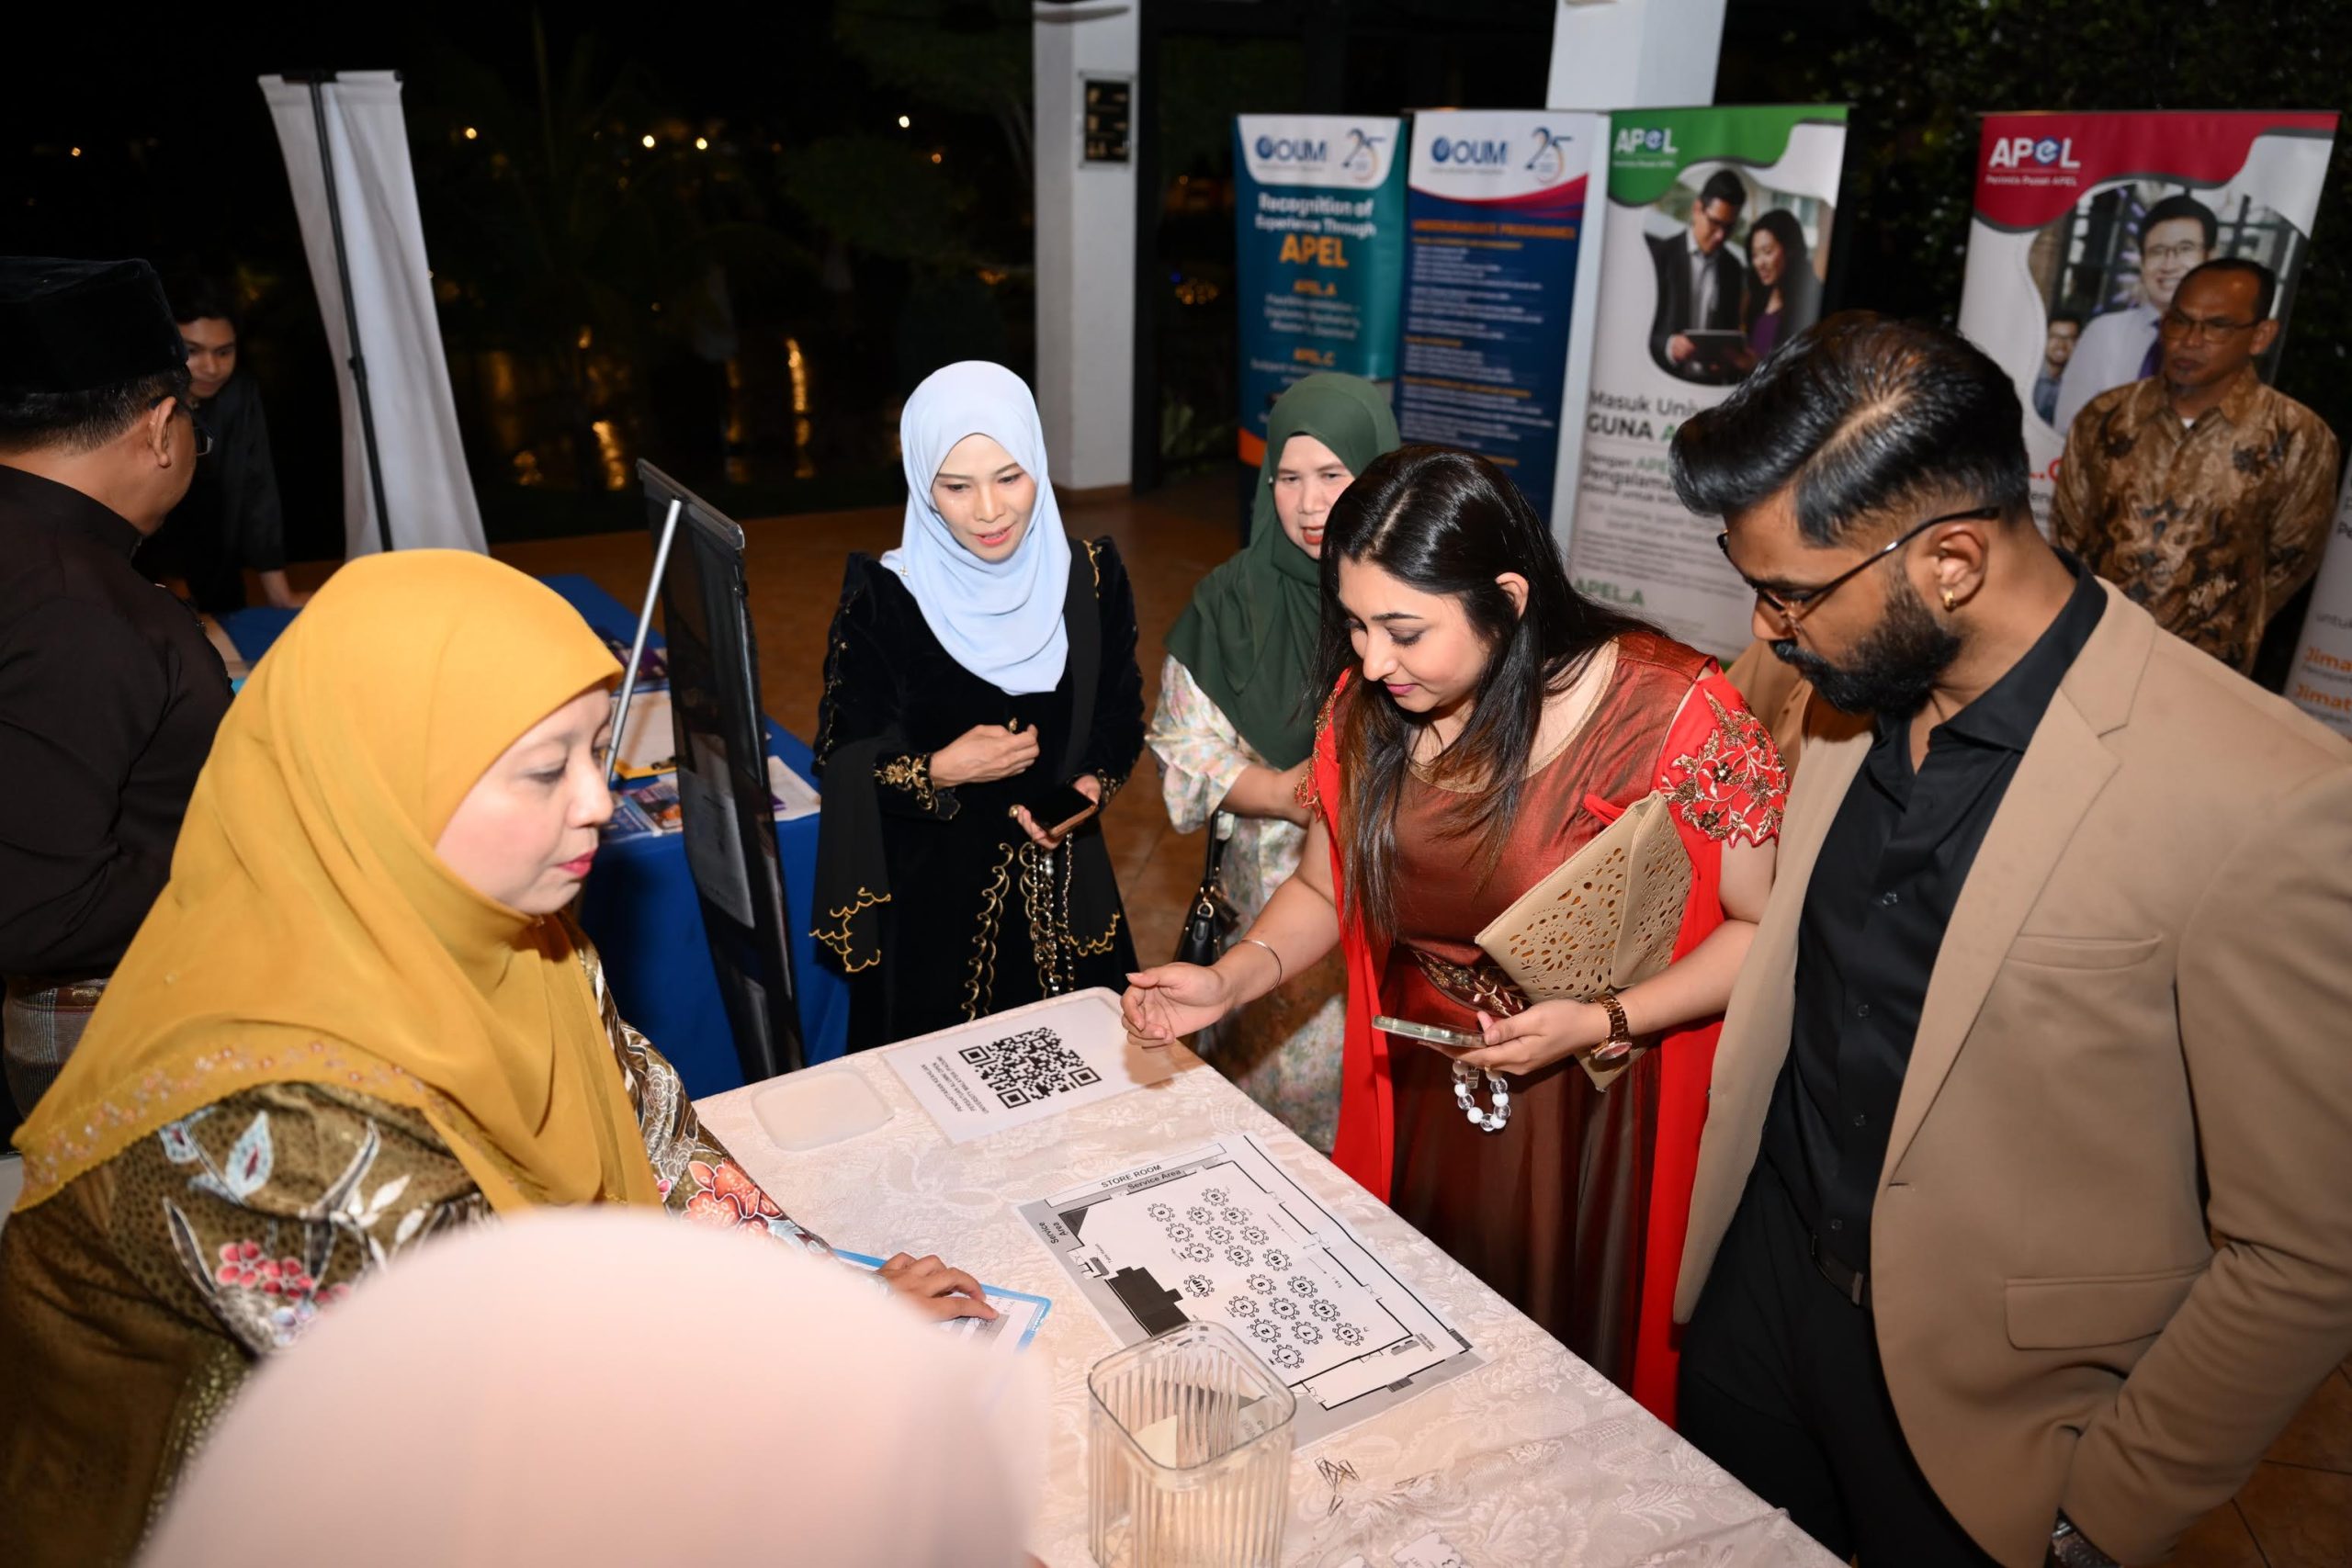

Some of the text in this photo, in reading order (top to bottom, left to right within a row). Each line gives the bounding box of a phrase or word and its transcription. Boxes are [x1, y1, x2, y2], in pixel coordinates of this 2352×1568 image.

[1275, 139, 1328, 163] OUM
[1453, 140, 1508, 164] OUM
[1258, 192, 1374, 217] Recognition of
[1323, 219, 1377, 239] Through
[1279, 232, 1349, 267] APEL
[1587, 412, 1654, 440] GUNA
[1101, 1164, 1163, 1189] STORE ROOM
[1127, 1169, 1182, 1190] Service Area
[1194, 1211, 1204, 1220] 12
[1038, 1222, 1059, 1245] Service
[1052, 1222, 1069, 1236] Area
[1214, 1231, 1224, 1239] 11
[1250, 1231, 1260, 1239] 17
[1233, 1251, 1244, 1260] 10
[1271, 1255, 1283, 1266] 16
[1192, 1279, 1206, 1293] VIP
[1296, 1282, 1308, 1292] 15
[1319, 1305, 1330, 1315] 14
[1342, 1329, 1354, 1339] 13
